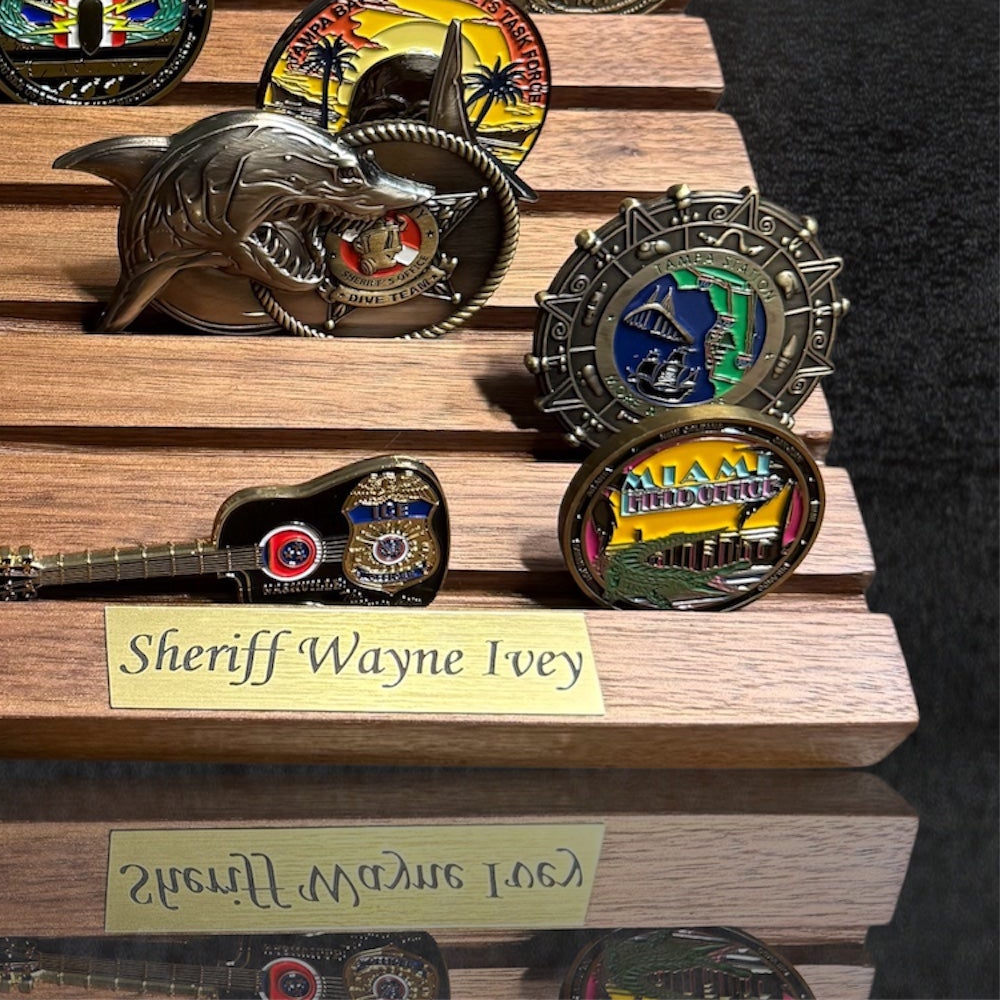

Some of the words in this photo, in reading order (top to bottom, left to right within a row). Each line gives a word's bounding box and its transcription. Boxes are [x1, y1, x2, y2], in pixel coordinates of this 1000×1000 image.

[287, 17, 333, 71] TAMPA
[500, 9, 533, 50] TASK
[521, 48, 541, 104] FORCE
[397, 254, 428, 282] OFFICE
[654, 252, 714, 275] TAMPA
[722, 255, 777, 302] STATION
[349, 292, 384, 304] DIVE
[391, 278, 431, 302] TEAM
[622, 452, 772, 490] MIAMI
[372, 502, 409, 520] ICE
[627, 488, 695, 514] FIELD
[697, 475, 781, 504] OFFICE
[119, 628, 292, 686] Sheriff
[299, 631, 464, 689] Wayne
[482, 639, 584, 691] Ivey
